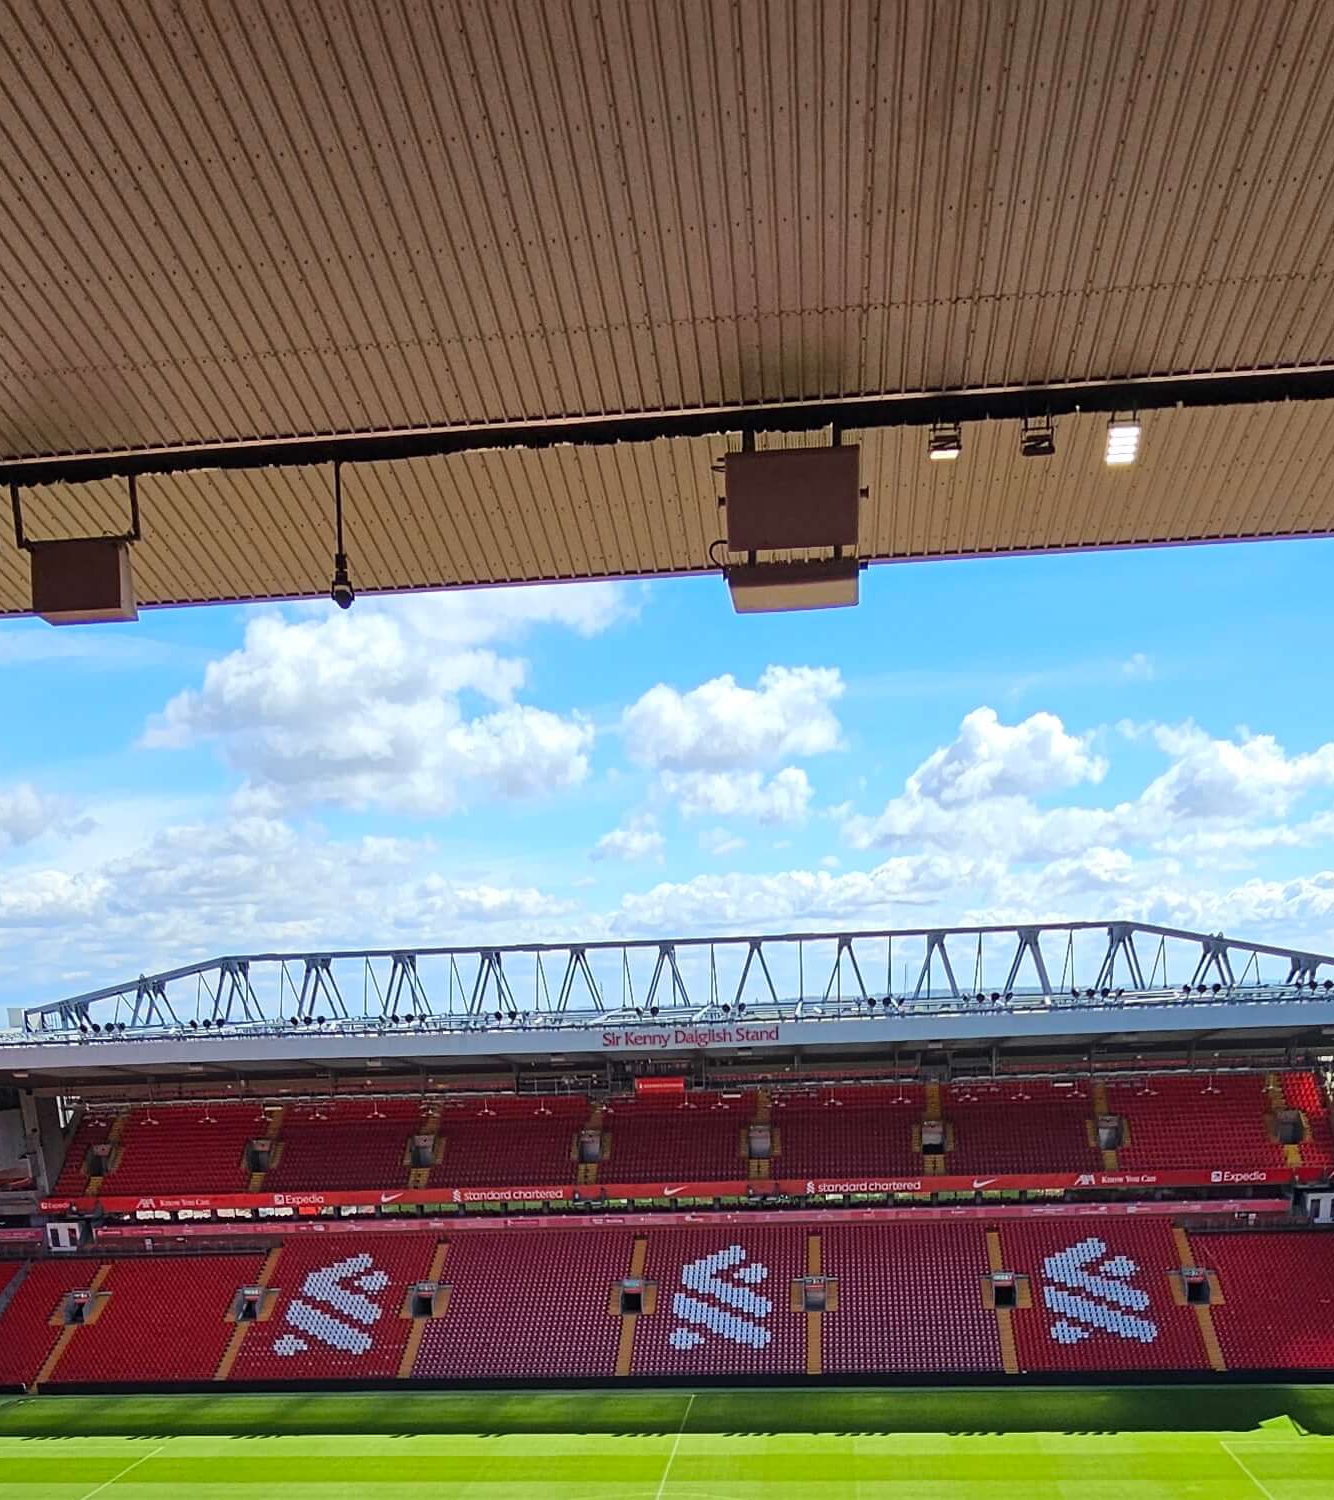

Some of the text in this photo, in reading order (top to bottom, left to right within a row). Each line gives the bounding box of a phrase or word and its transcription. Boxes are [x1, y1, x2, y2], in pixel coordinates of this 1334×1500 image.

[603, 1026, 779, 1048] Sir Kenny Dalglish Stand
[1223, 1170, 1267, 1182] Expedia
[818, 1180, 921, 1193] standard chartered
[285, 1194, 324, 1205] Expedia
[463, 1188, 564, 1202] standard chartered
